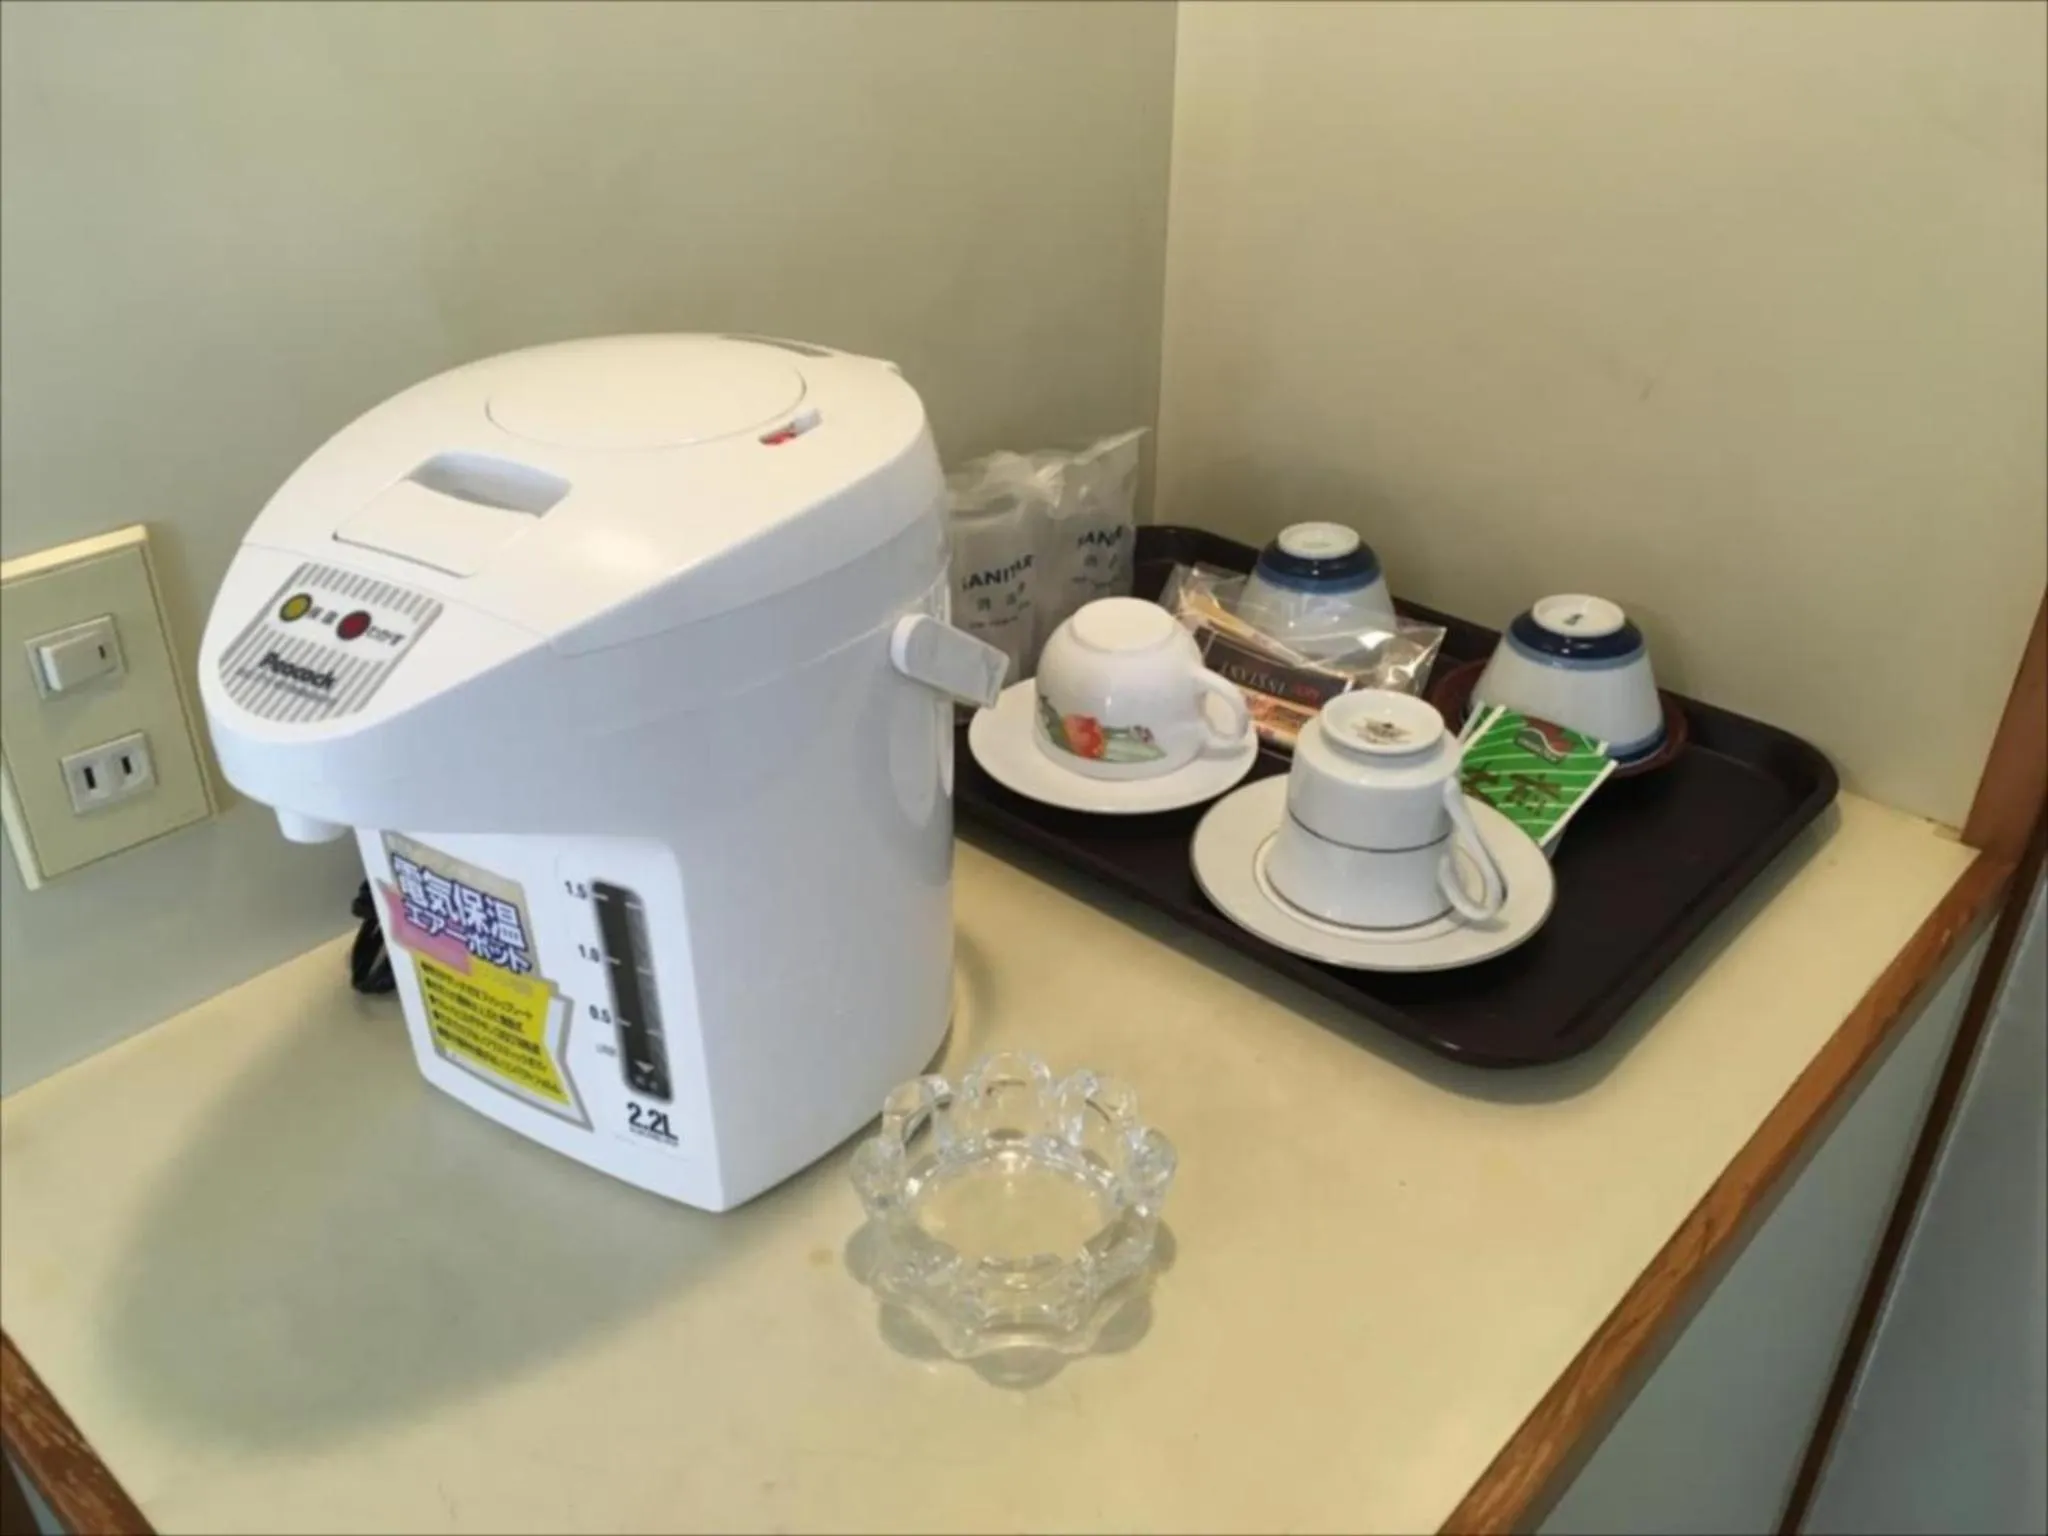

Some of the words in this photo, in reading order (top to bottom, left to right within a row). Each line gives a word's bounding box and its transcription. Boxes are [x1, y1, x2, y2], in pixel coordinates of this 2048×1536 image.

[564, 880, 587, 900] 1.5
[392, 852, 528, 952] 電気保温
[578, 944, 600, 963] 1.0
[588, 1004, 611, 1024] 0.5
[626, 1102, 679, 1143] 2.2L
